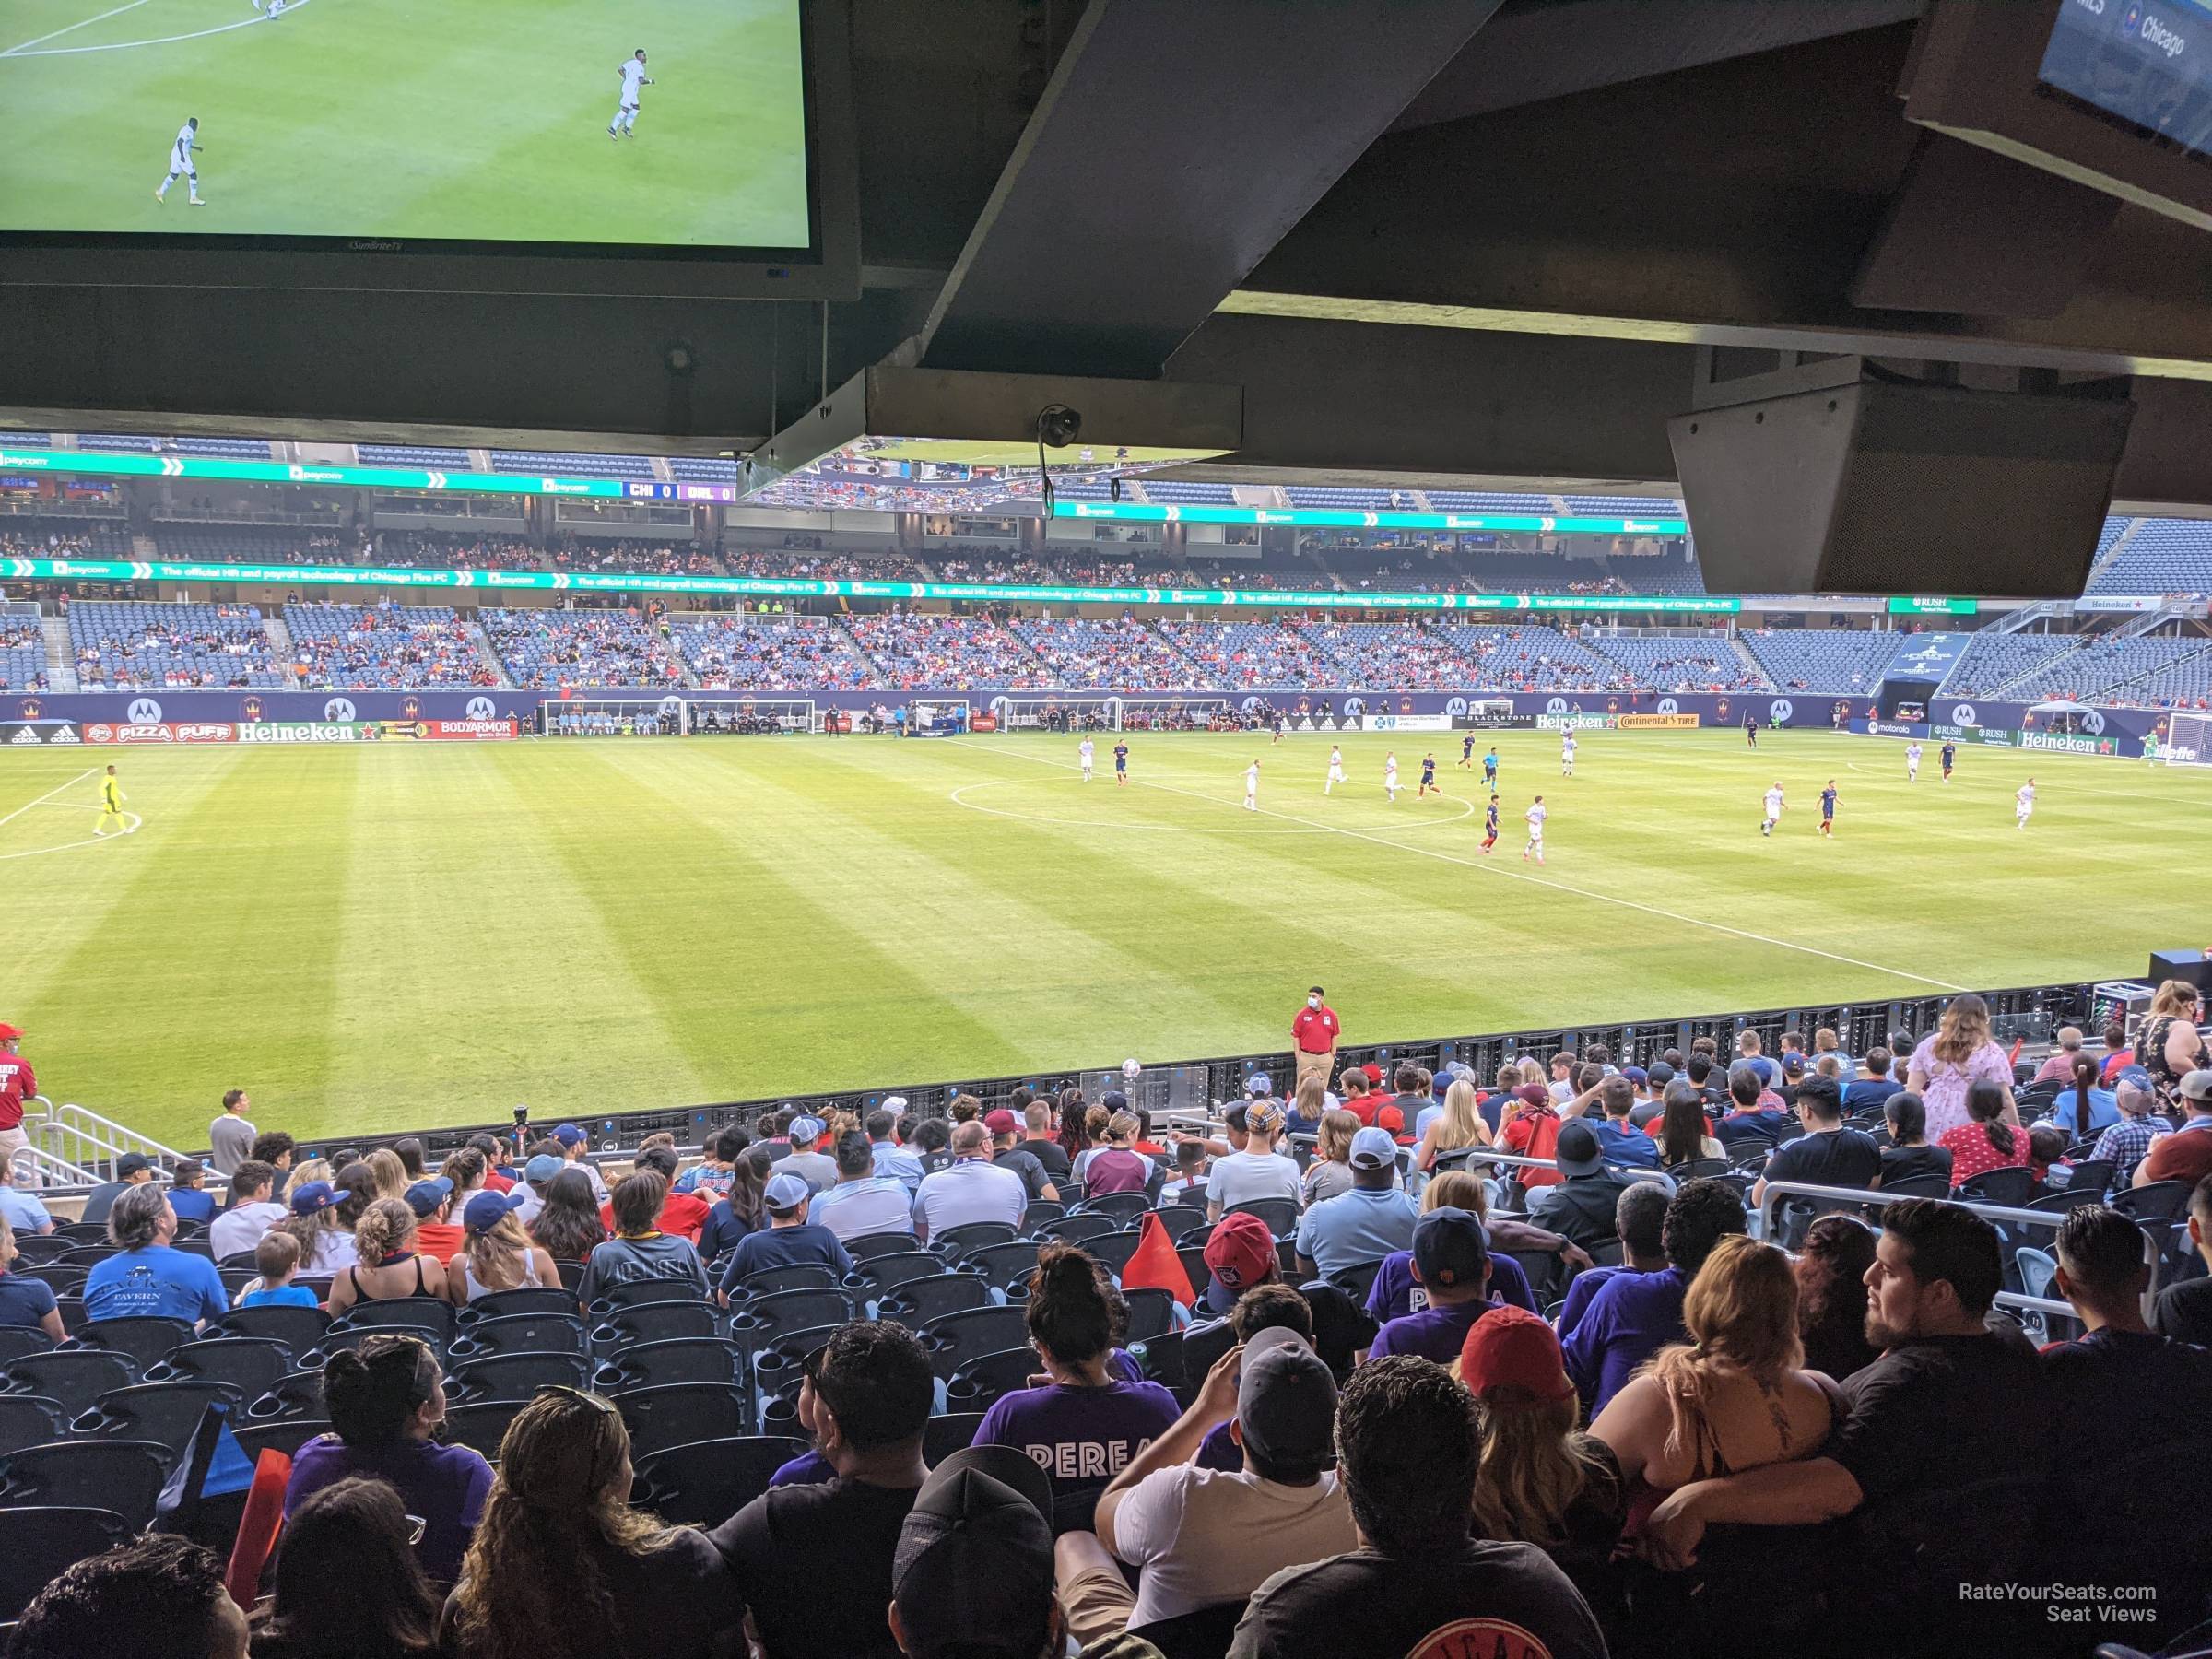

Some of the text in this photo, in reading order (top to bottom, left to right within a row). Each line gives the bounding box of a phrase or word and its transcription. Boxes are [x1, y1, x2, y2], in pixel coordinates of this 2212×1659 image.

[2141, 16, 2185, 57] Chicago
[4, 457, 48, 465] paycom
[303, 471, 343, 479] paycom
[554, 484, 590, 492] paycom
[629, 484, 671, 497] CHI 0
[688, 487, 730, 500] ORL 0
[1086, 508, 1115, 516] paycom
[67, 566, 110, 574] paycom
[162, 567, 448, 584] The official HR and payroll technology of Chicago Fire FC
[500, 576, 535, 584] paycom
[578, 577, 594, 585] The
[596, 578, 626, 586] official
[629, 579, 641, 587] HR
[642, 579, 660, 588] and
[661, 580, 691, 590] payroll
[693, 581, 737, 591] technology
[751, 583, 785, 593] Chicago
[1083, 590, 1112, 600] Chicago
[1382, 597, 1411, 606] Chicago
[1922, 597, 1947, 606] RUSH
[2092, 600, 2132, 609] Heineken
[1620, 715, 1697, 727] Continental TIRE
[118, 724, 172, 740] PIZZA
[177, 724, 231, 740] PUFF
[237, 723, 355, 741] Heineken
[441, 722, 512, 733] BODYARMOR
[1878, 724, 1910, 734] motorola
[1941, 725, 1962, 735] RUSH
[1985, 728, 2007, 738] RUSH
[2021, 732, 2096, 753] Heineken
[2155, 744, 2196, 760] illette
